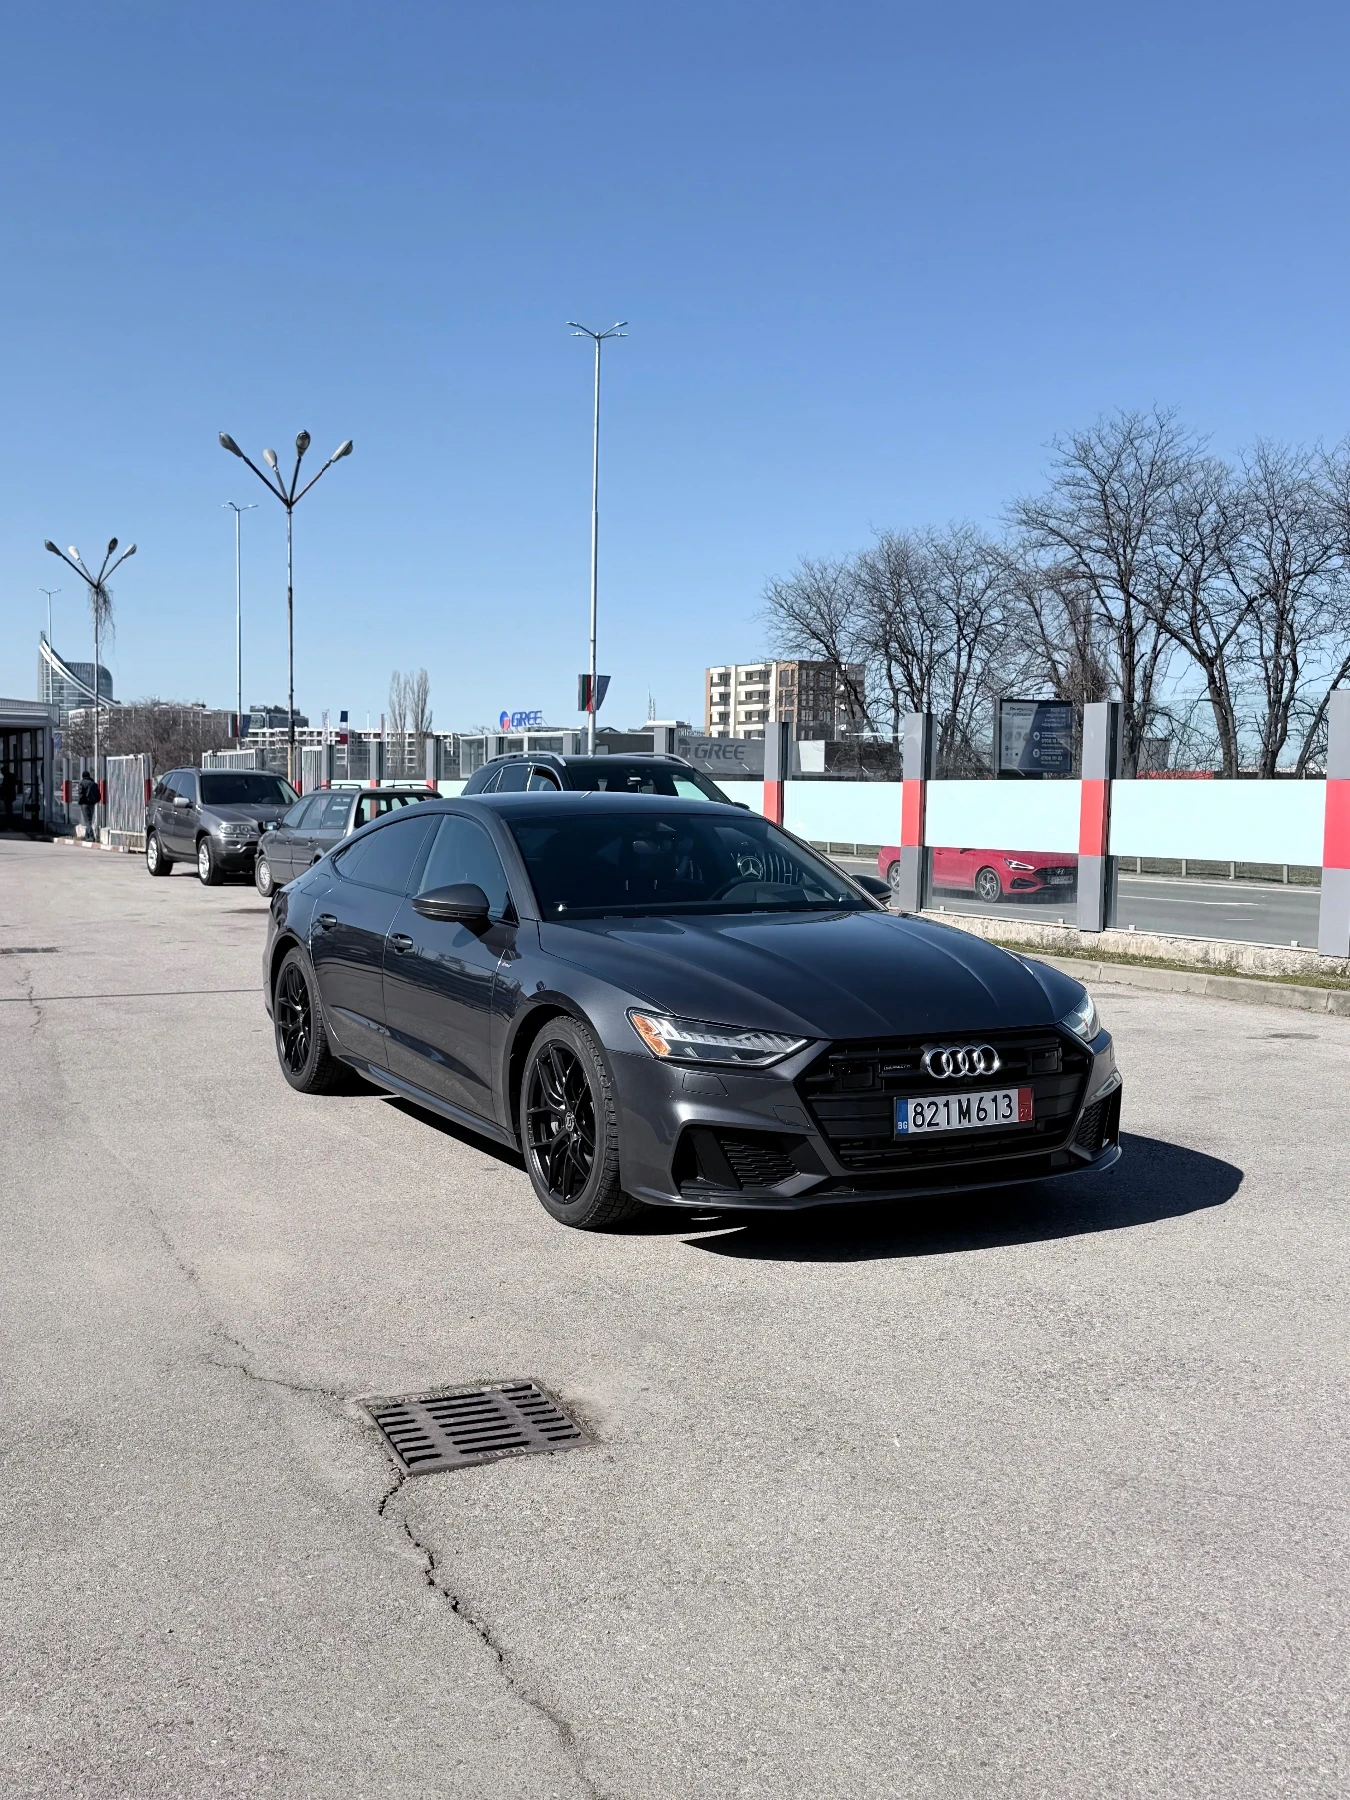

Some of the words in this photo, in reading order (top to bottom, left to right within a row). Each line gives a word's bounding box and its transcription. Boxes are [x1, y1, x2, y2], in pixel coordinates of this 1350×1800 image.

[511, 710, 543, 727] GREE
[694, 742, 746, 761] GREE
[897, 1122, 908, 1130] BG
